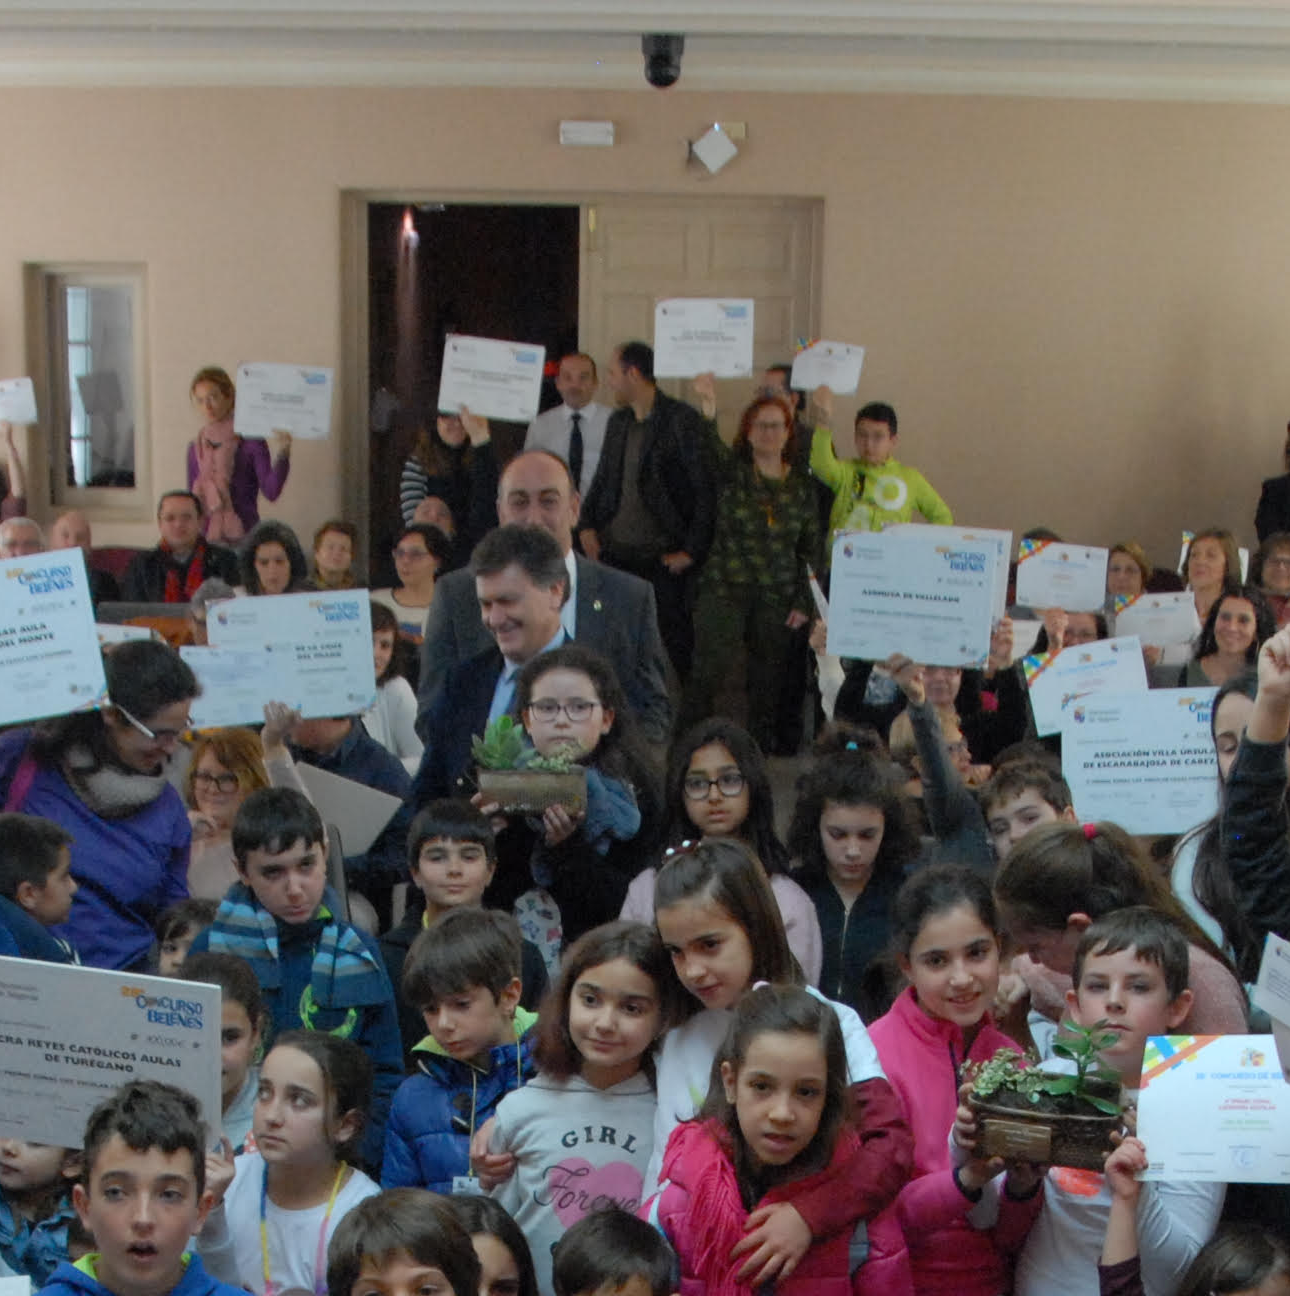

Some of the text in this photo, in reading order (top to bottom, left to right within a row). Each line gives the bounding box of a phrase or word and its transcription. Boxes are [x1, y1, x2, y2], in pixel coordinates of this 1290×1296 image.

[1083, 760, 1095, 769] DE
[1184, 757, 1218, 766] CABEZ
[135, 994, 205, 1017] CONCURSO
[147, 1008, 204, 1030] BELENES
[28, 1037, 65, 1052] REYES
[140, 1053, 182, 1068] AULAS
[44, 1053, 60, 1063] DE
[561, 1125, 638, 1155] GIRL
